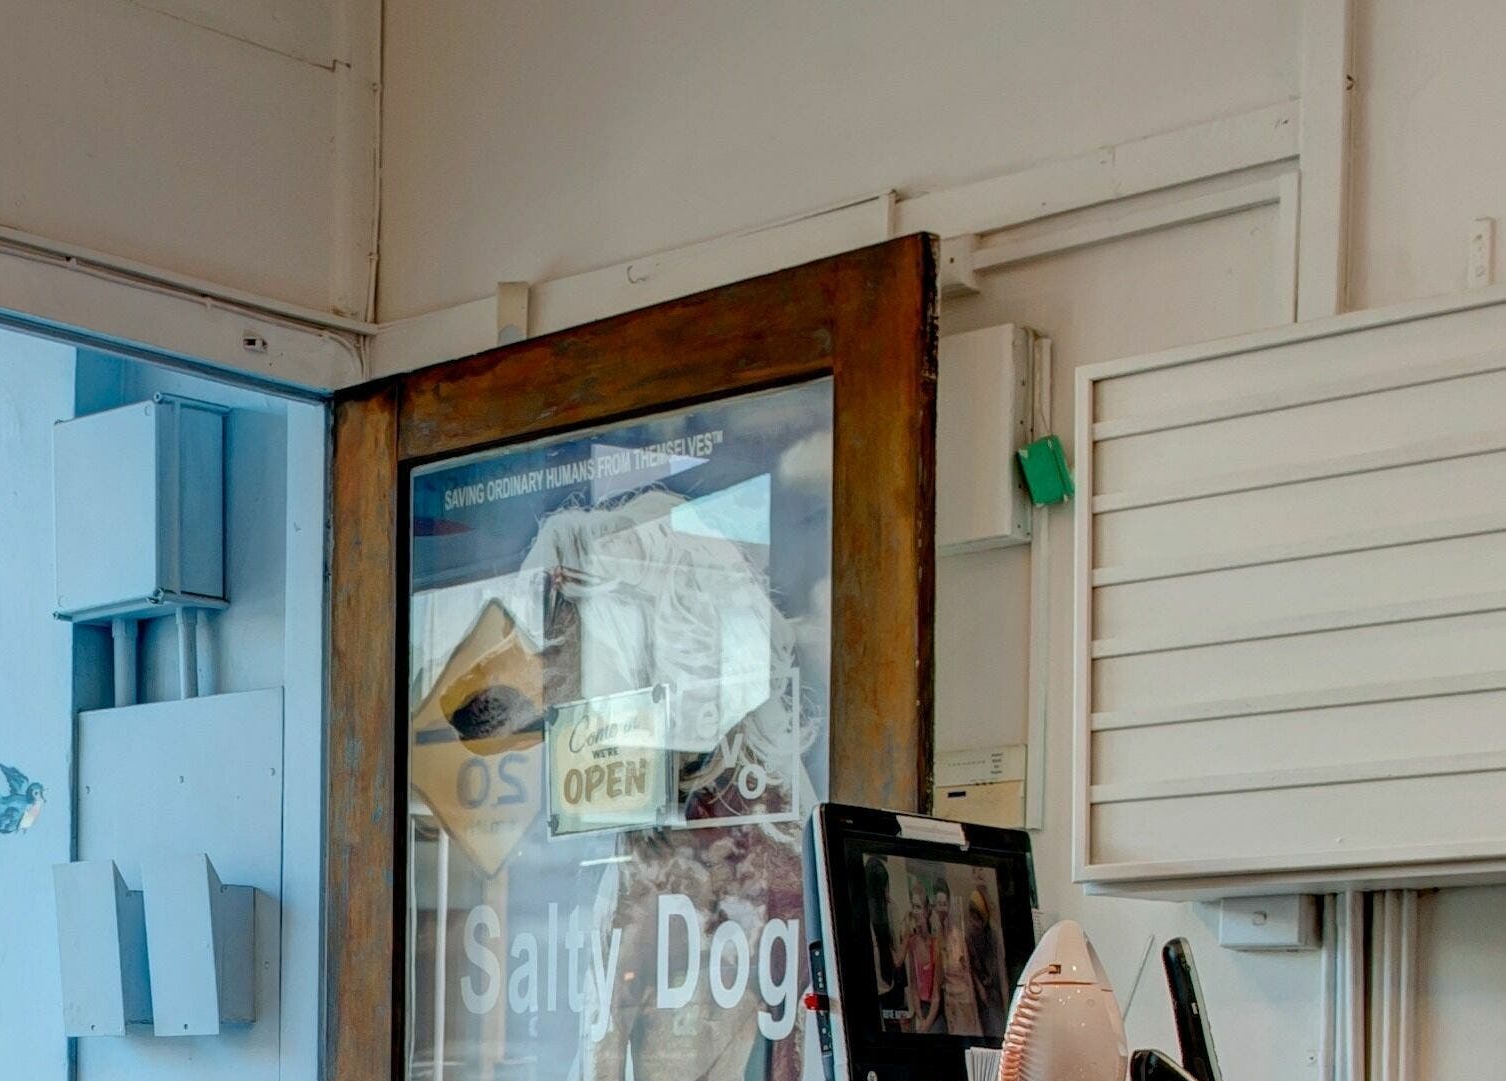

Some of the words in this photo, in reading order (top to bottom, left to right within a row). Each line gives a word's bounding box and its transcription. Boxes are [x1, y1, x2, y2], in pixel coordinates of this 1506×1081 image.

[445, 483, 484, 510] SAVING
[487, 470, 543, 501] ORDINARY
[546, 459, 594, 490] HUMANS
[597, 450, 631, 479] FROM
[563, 758, 646, 805] OPEN
[460, 902, 622, 1042] Salty
[656, 894, 799, 1040] Dog
